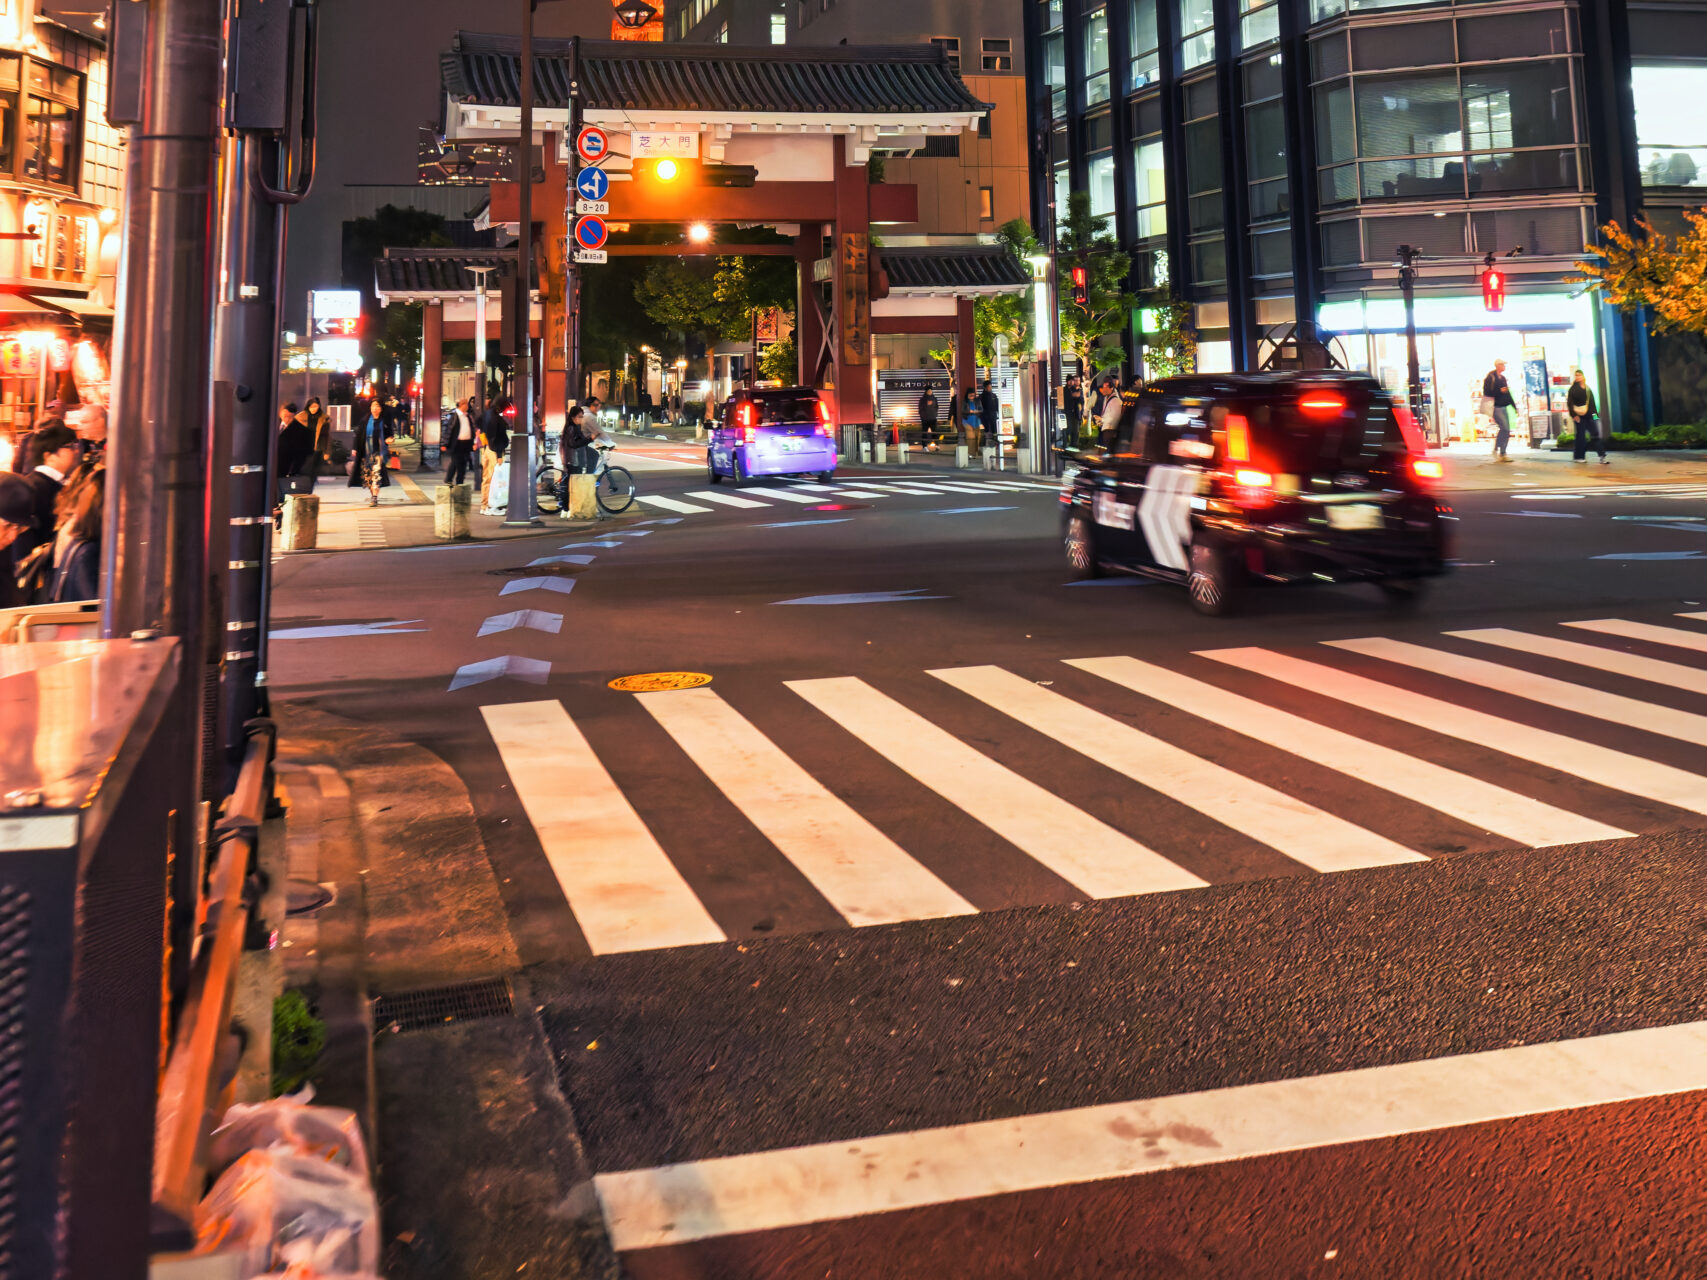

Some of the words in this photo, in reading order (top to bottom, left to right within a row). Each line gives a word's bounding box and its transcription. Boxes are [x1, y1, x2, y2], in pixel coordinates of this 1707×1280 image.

[640, 136, 691, 148] 芝大門
[582, 203, 605, 212] 8-20
[344, 319, 356, 334] P
